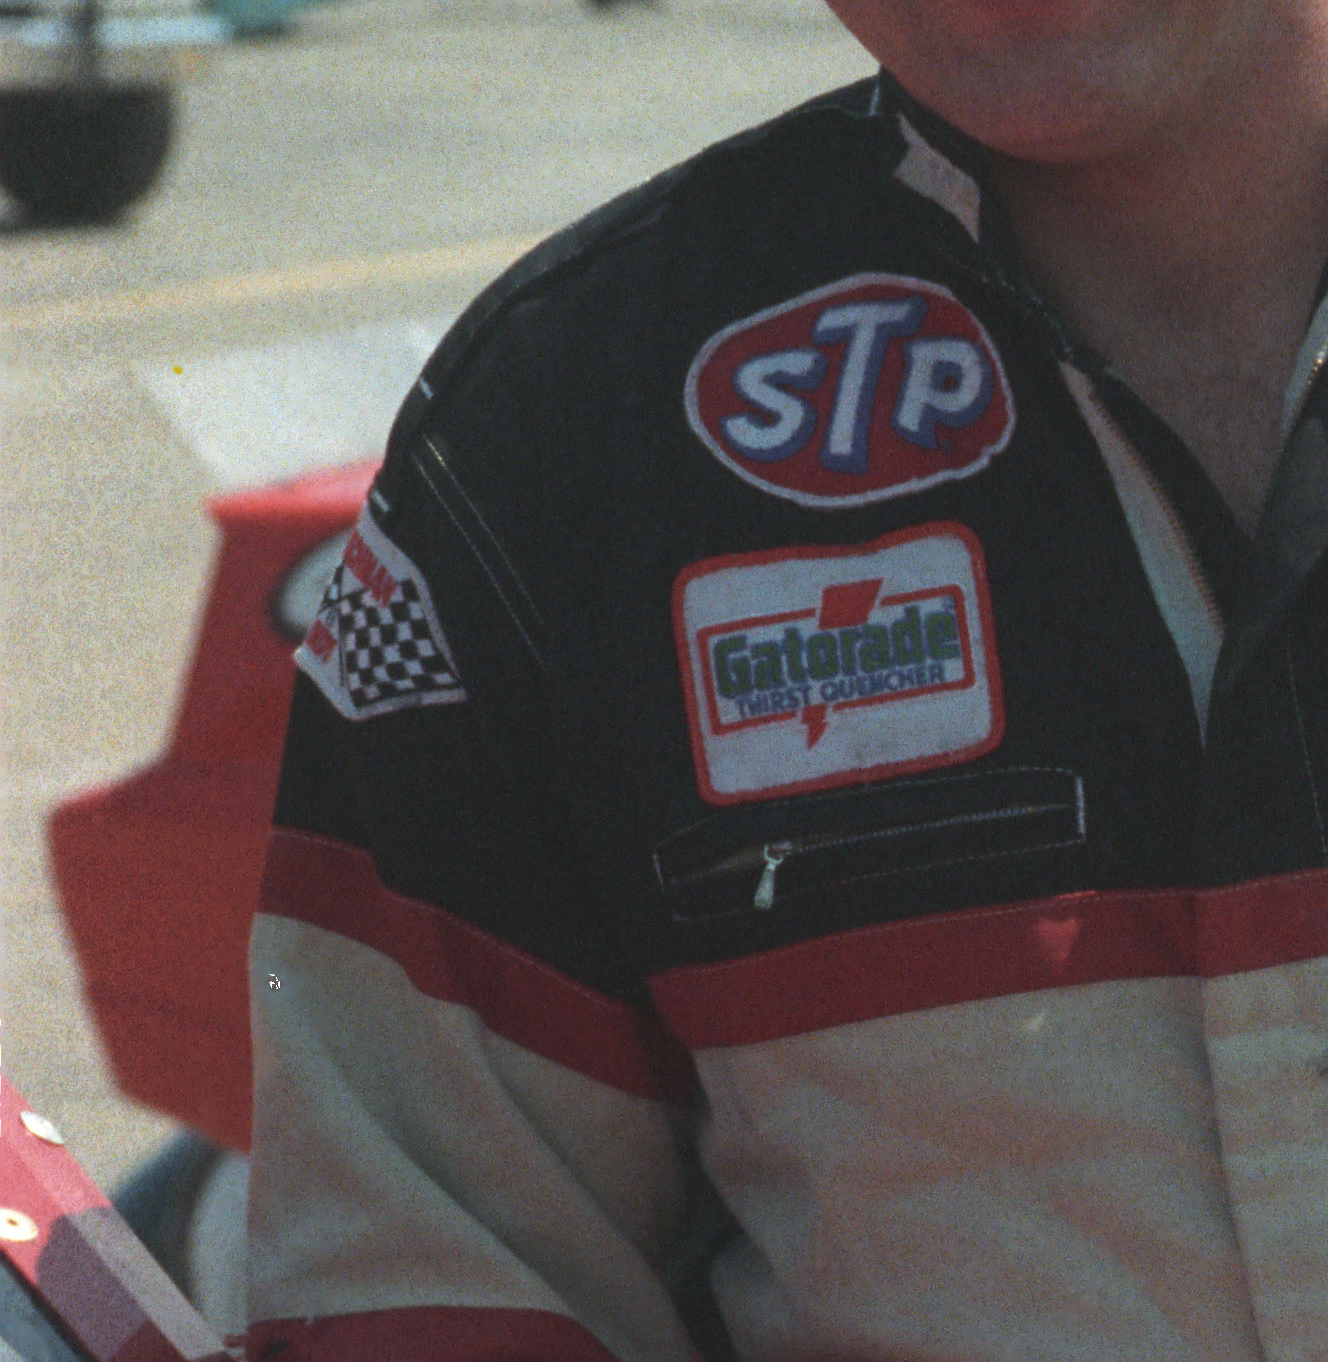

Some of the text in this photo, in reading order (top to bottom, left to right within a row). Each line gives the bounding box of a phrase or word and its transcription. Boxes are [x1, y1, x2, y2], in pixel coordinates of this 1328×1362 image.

[719, 293, 994, 475] STP
[714, 604, 962, 699] Gatorade
[734, 663, 946, 719] THIRST QUENCHER
